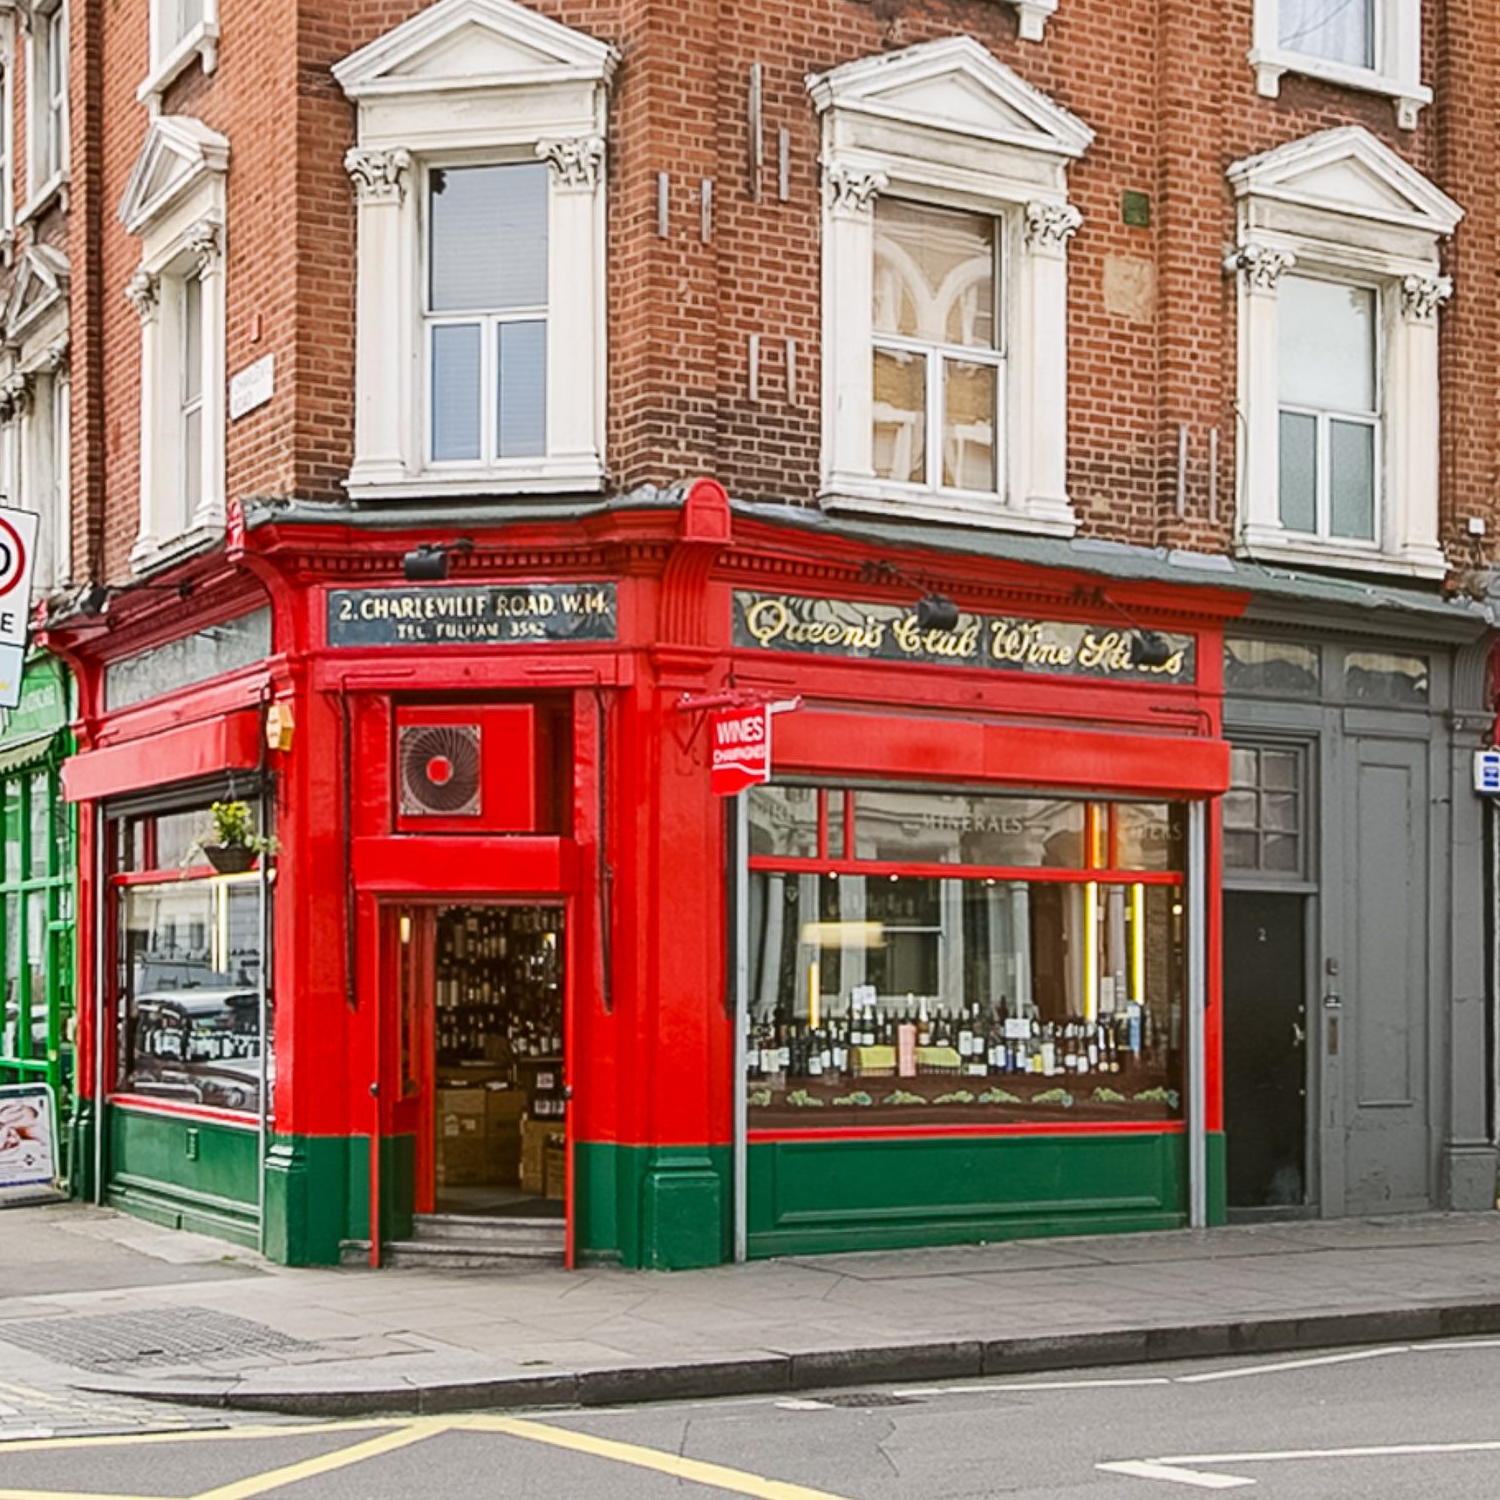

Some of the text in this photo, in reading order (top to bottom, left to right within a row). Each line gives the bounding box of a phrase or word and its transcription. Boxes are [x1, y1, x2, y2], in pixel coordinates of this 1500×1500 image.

[892, 613, 979, 658] Club
[991, 621, 1075, 665] Wine
[716, 715, 764, 745] WINES
[923, 812, 1023, 835] MINERALS
[1258, 927, 1267, 941] 2
